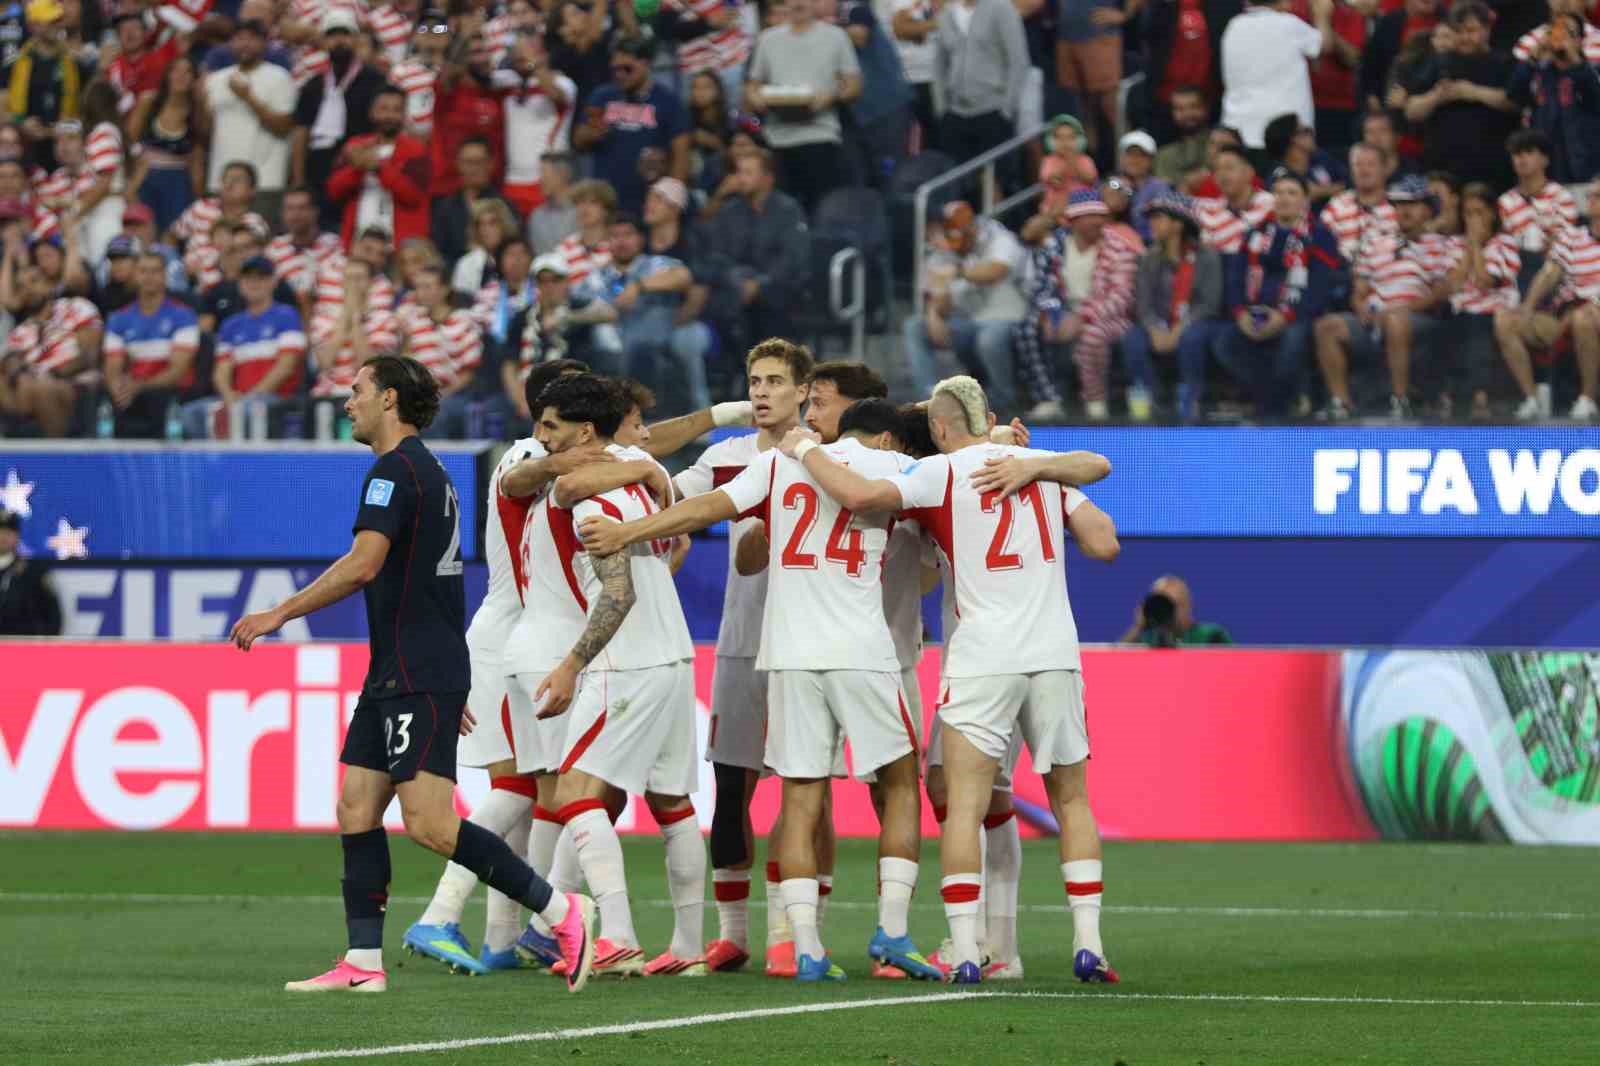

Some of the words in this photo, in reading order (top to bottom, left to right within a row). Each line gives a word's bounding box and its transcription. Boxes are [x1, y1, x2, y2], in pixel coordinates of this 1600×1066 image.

[1313, 449, 1478, 515] FIFA
[1489, 449, 1600, 515] WO
[781, 482, 866, 577] 24
[980, 480, 1057, 572] 21
[54, 569, 312, 641] FIFA
